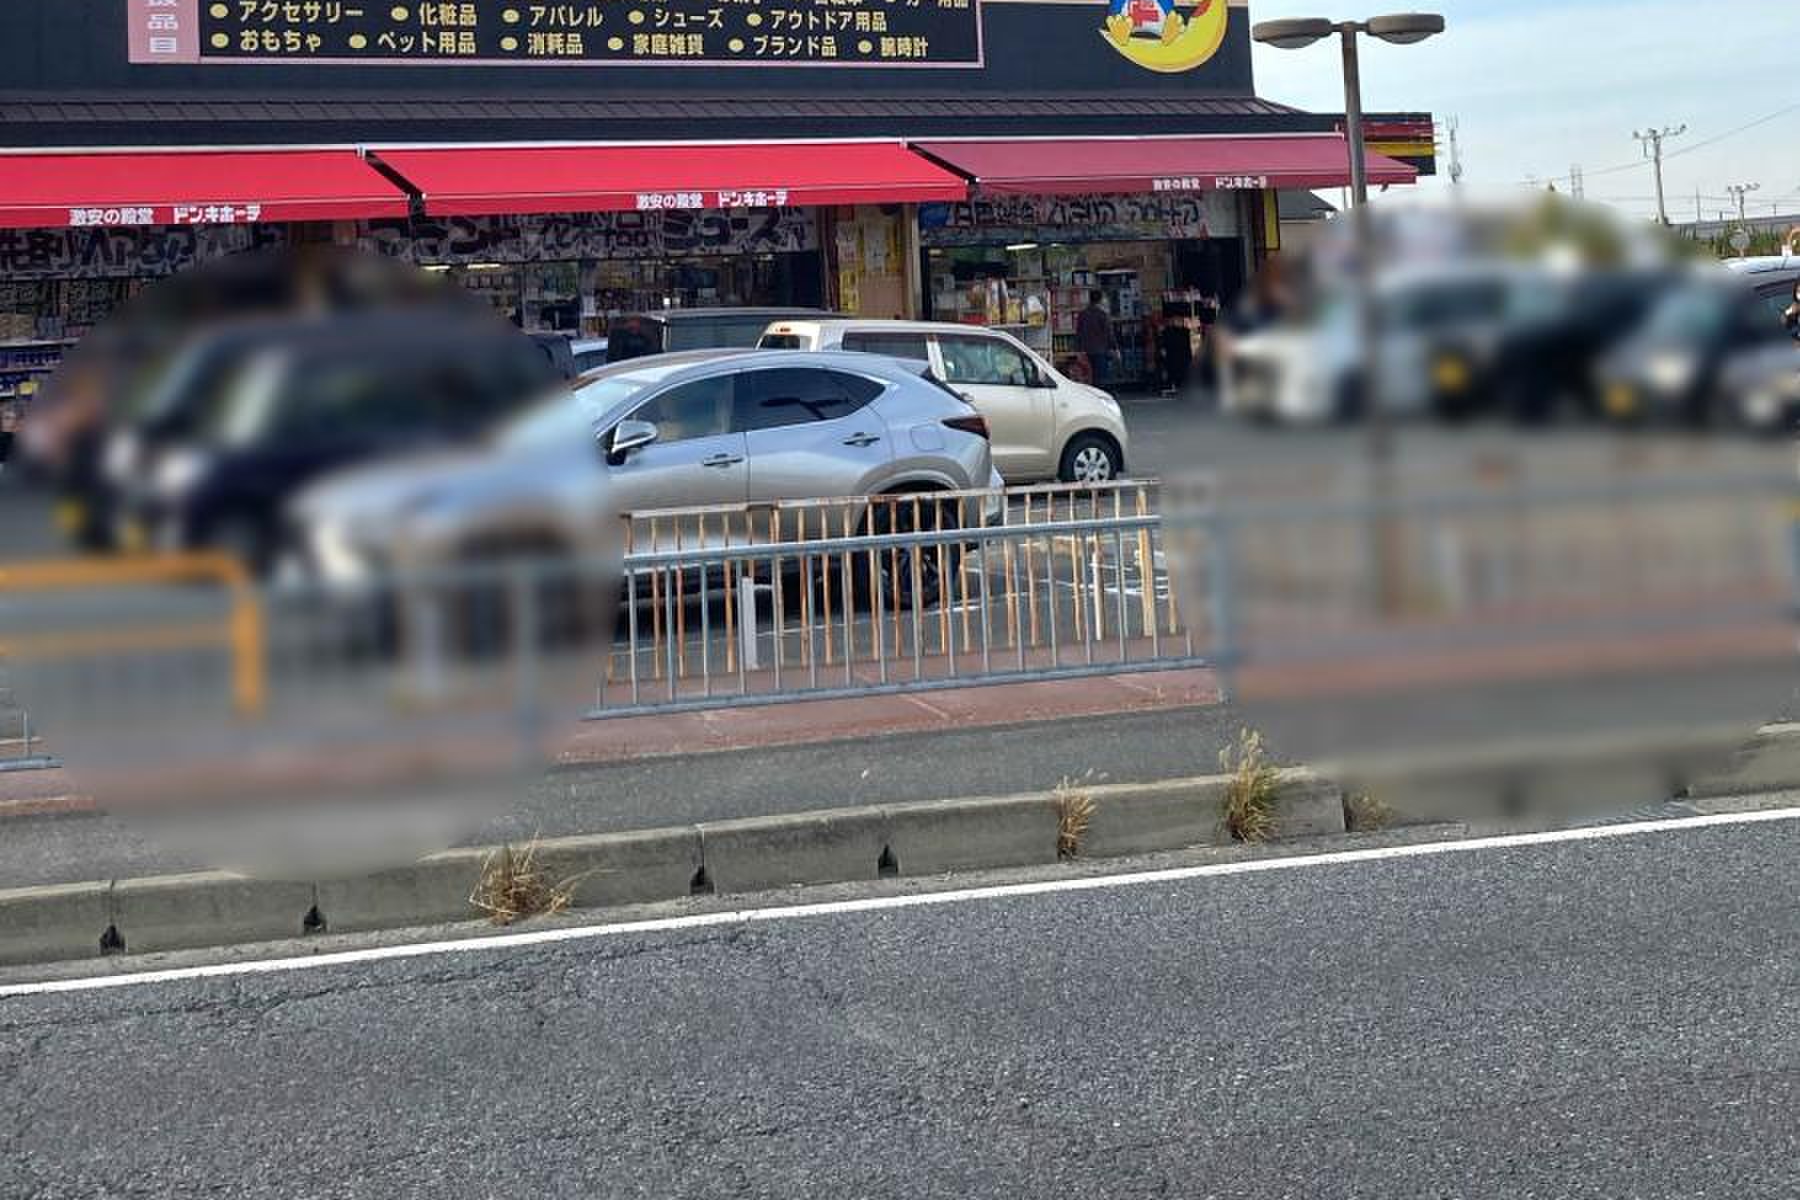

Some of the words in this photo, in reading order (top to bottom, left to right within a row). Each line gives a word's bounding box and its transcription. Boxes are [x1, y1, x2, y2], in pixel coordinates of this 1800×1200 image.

[238, 1, 364, 23] アクセサリー
[418, 2, 478, 26] 化粧品
[529, 8, 604, 28] アパレル
[654, 8, 724, 29] シューズ
[769, 10, 888, 32] アウトドア用品
[239, 30, 322, 52] おもちゃ
[377, 31, 477, 55] ペット用品
[527, 32, 584, 56] 消耗品
[633, 34, 705, 56] 家庭雑貨
[752, 35, 838, 57] ブランド品
